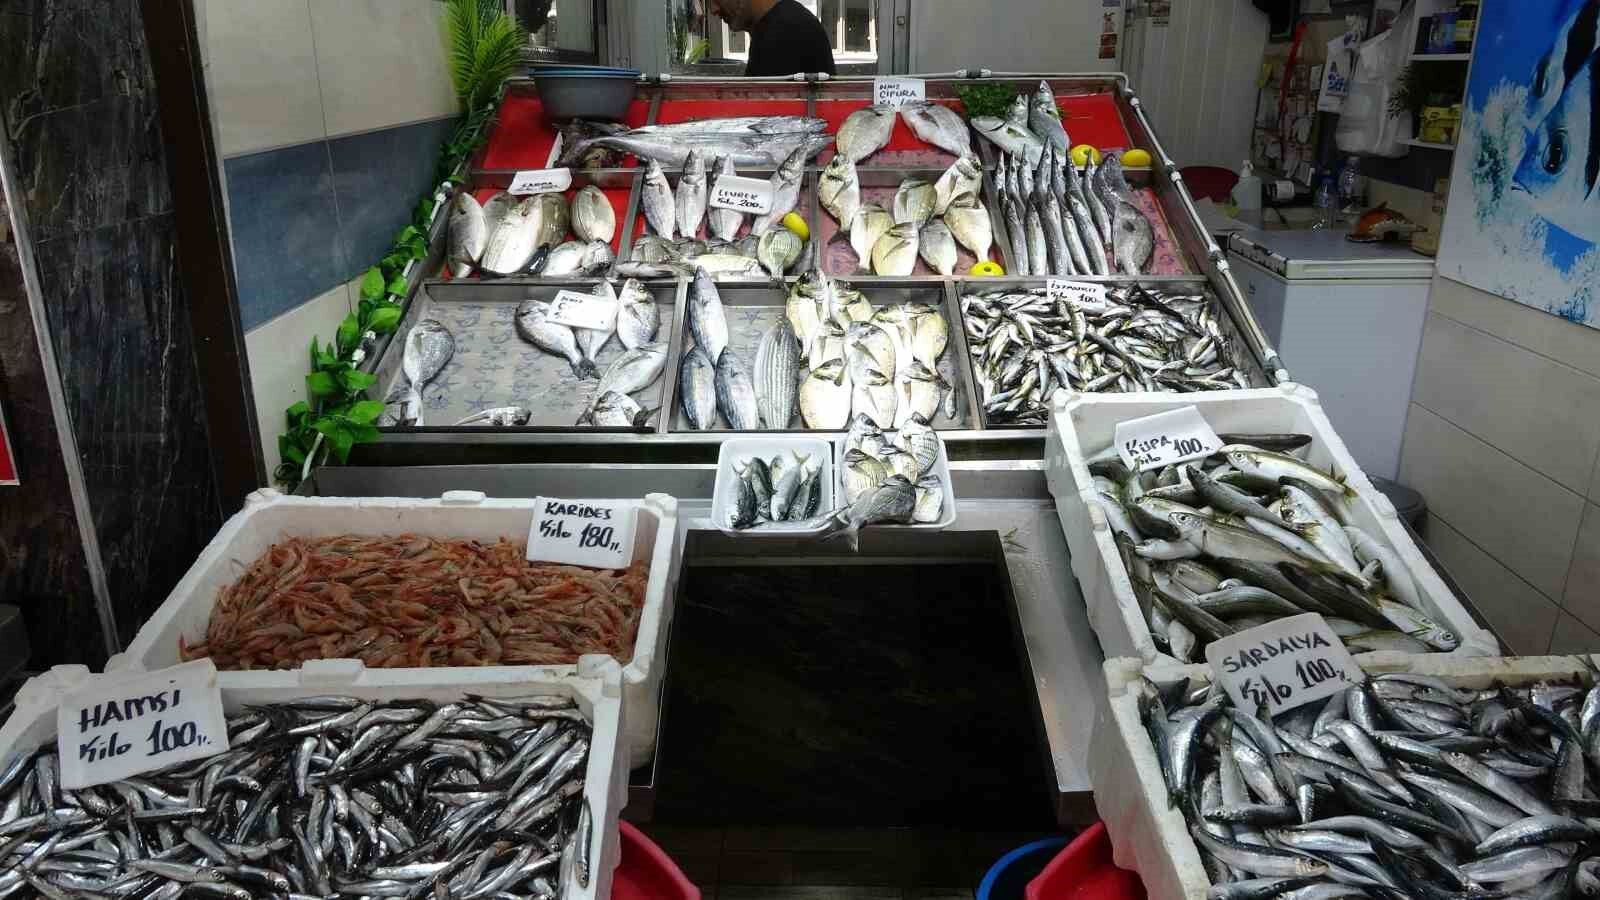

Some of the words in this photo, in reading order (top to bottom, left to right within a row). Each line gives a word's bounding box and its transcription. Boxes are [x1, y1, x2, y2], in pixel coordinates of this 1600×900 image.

[545, 501, 613, 520] KARİDES
[540, 519, 572, 538] Kilo
[1222, 631, 1332, 673] SARDALYA
[1240, 674, 1293, 706] Kilo
[79, 732, 132, 763] Kilo
